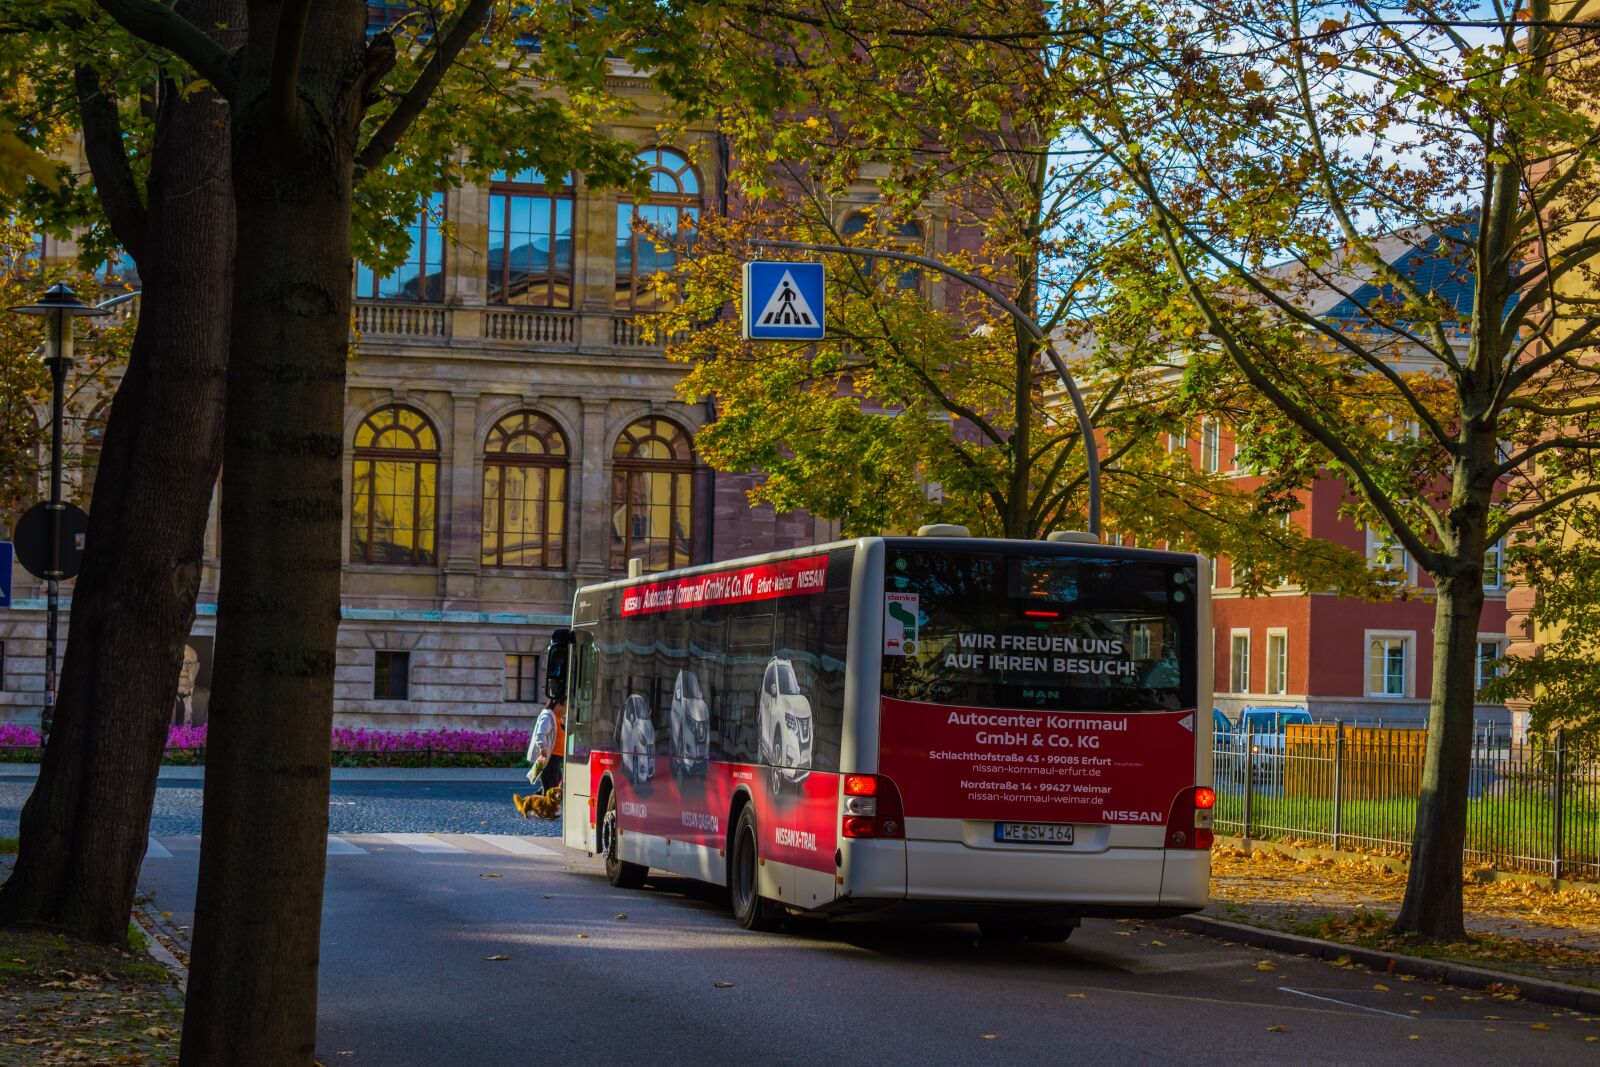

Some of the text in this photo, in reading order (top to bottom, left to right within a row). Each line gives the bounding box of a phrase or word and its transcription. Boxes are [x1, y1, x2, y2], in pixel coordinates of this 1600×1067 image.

[757, 577, 793, 594] Erfurt Weimar
[797, 569, 825, 588] NISSAN
[624, 595, 643, 612] NISSAN
[643, 589, 675, 608] Autocenter
[704, 578, 724, 600] GmbH
[724, 576, 731, 596] &
[731, 574, 742, 597] Co.
[743, 573, 754, 596] KG
[887, 593, 917, 602] danke
[958, 633, 1123, 655] WIR FREUEN UNS
[944, 654, 1136, 676] AUF IHREN BESUCH!
[1023, 689, 1060, 699] MAN
[947, 711, 1128, 732] Autocenter Kornmaul
[975, 731, 1100, 749] GmbH & Co. KG
[929, 750, 1024, 763] Schlachthofstraße
[1026, 754, 1040, 763] 43
[1047, 755, 1080, 765] 99085
[1082, 757, 1112, 767] Erfurt
[972, 763, 1101, 777] nissan-kornmaul-erfurt.de
[960, 780, 1112, 795] Nordstraße 14 99427 Weimar
[968, 792, 1104, 805] nissan-kornmaul-weimar.de
[681, 811, 698, 828] NISSAN
[1102, 810, 1163, 822] NISSAN
[775, 827, 817, 852] NISSAN X-TRAIL
[1005, 824, 1072, 840] WE SW 164
